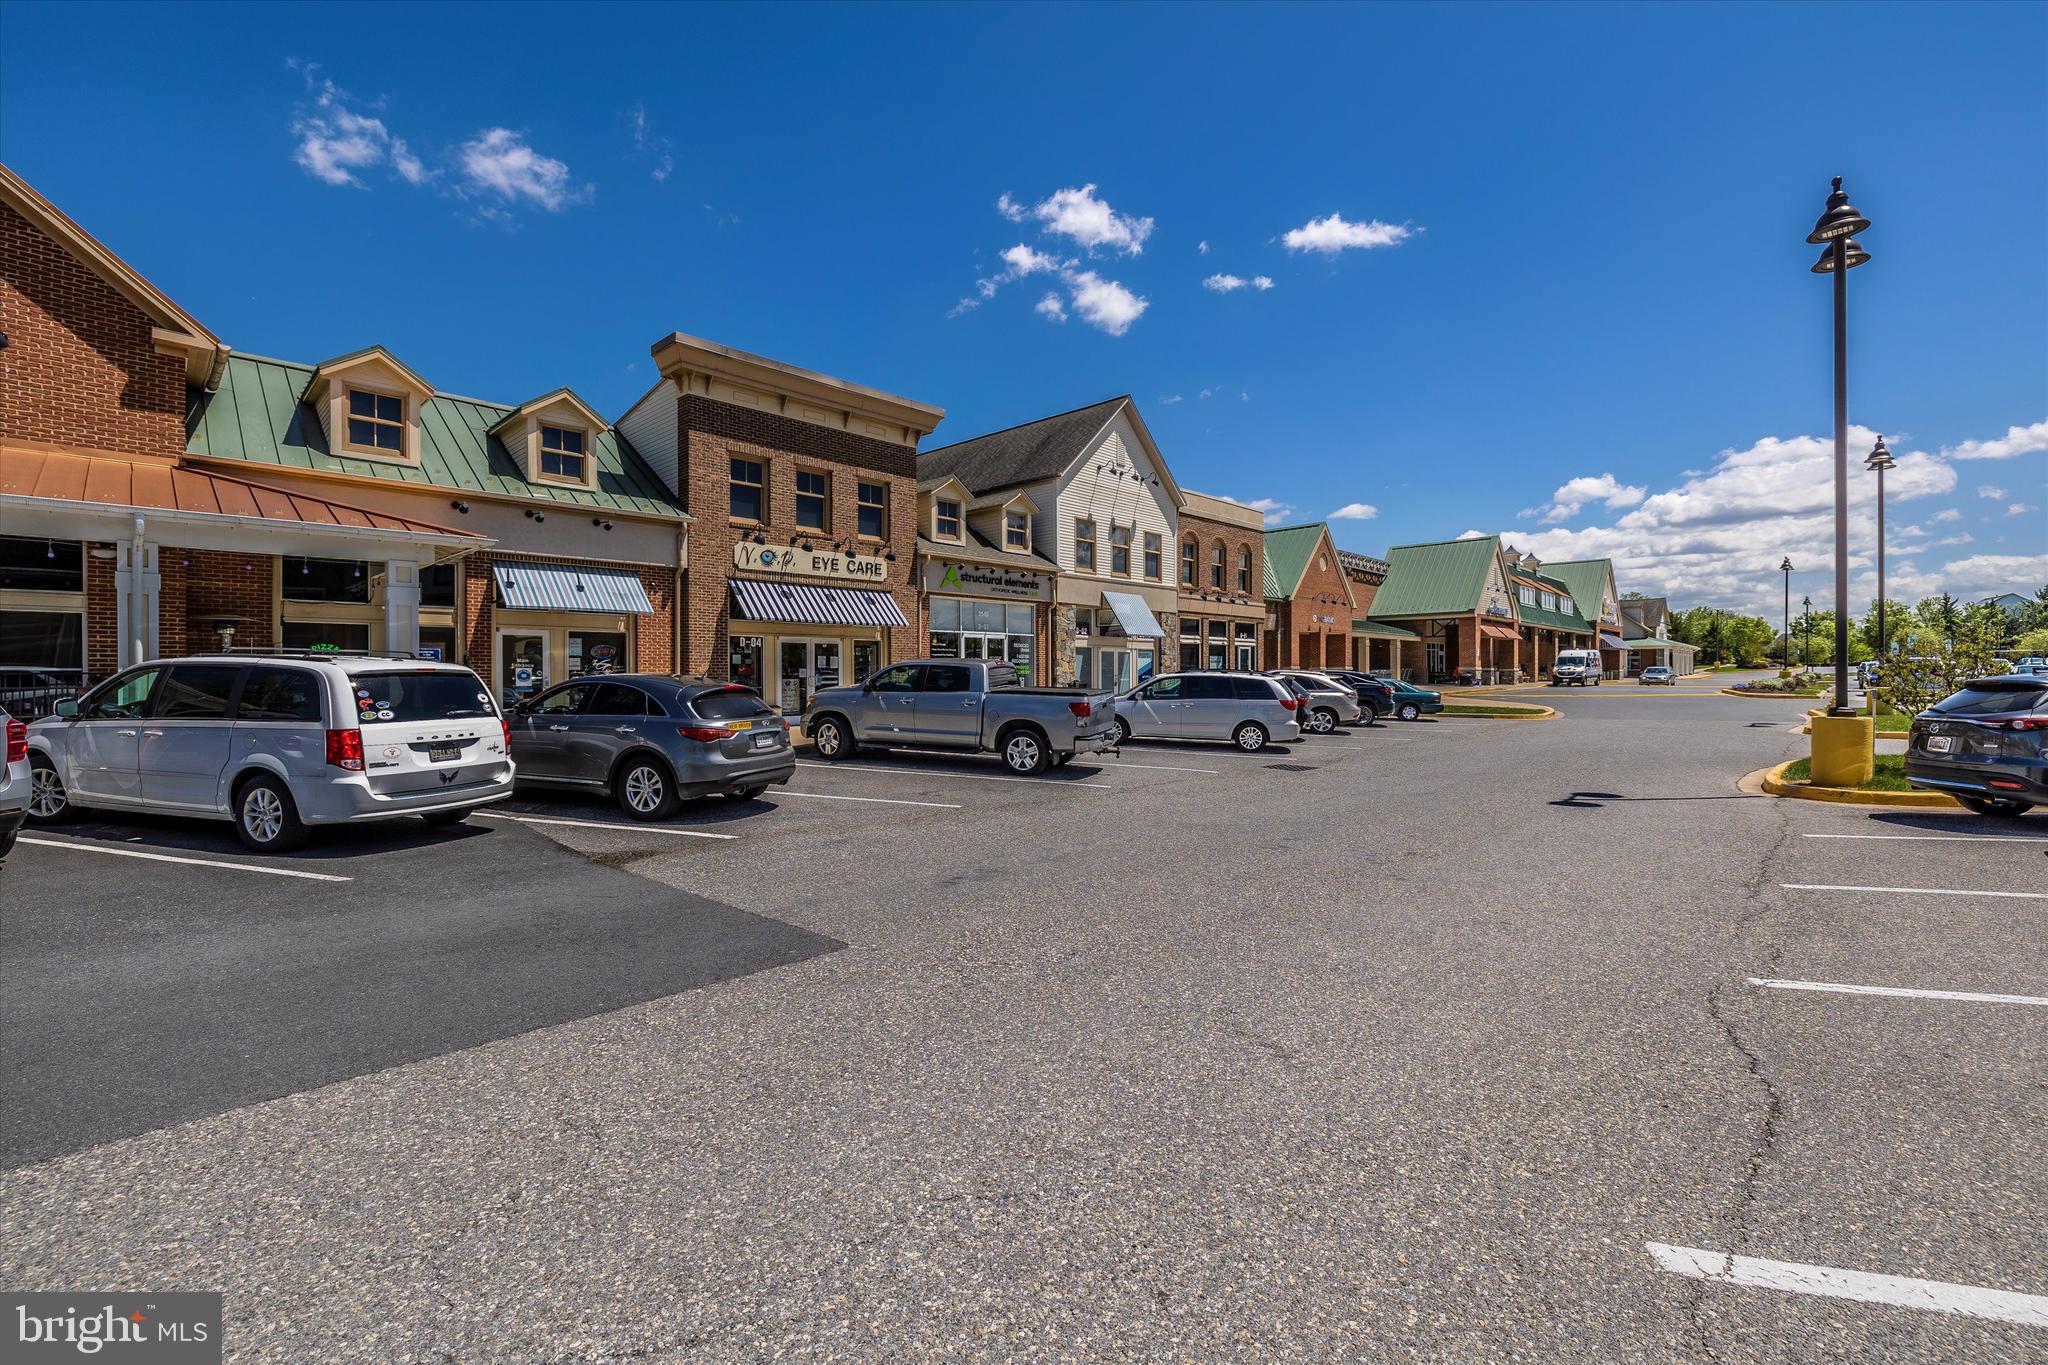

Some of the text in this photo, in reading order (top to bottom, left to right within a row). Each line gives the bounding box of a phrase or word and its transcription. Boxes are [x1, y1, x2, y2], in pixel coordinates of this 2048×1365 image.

[812, 557, 882, 576] EYE CARE
[960, 572, 1040, 590] structural elements
[311, 643, 339, 651] PIZZA
[740, 637, 761, 647] D-04
